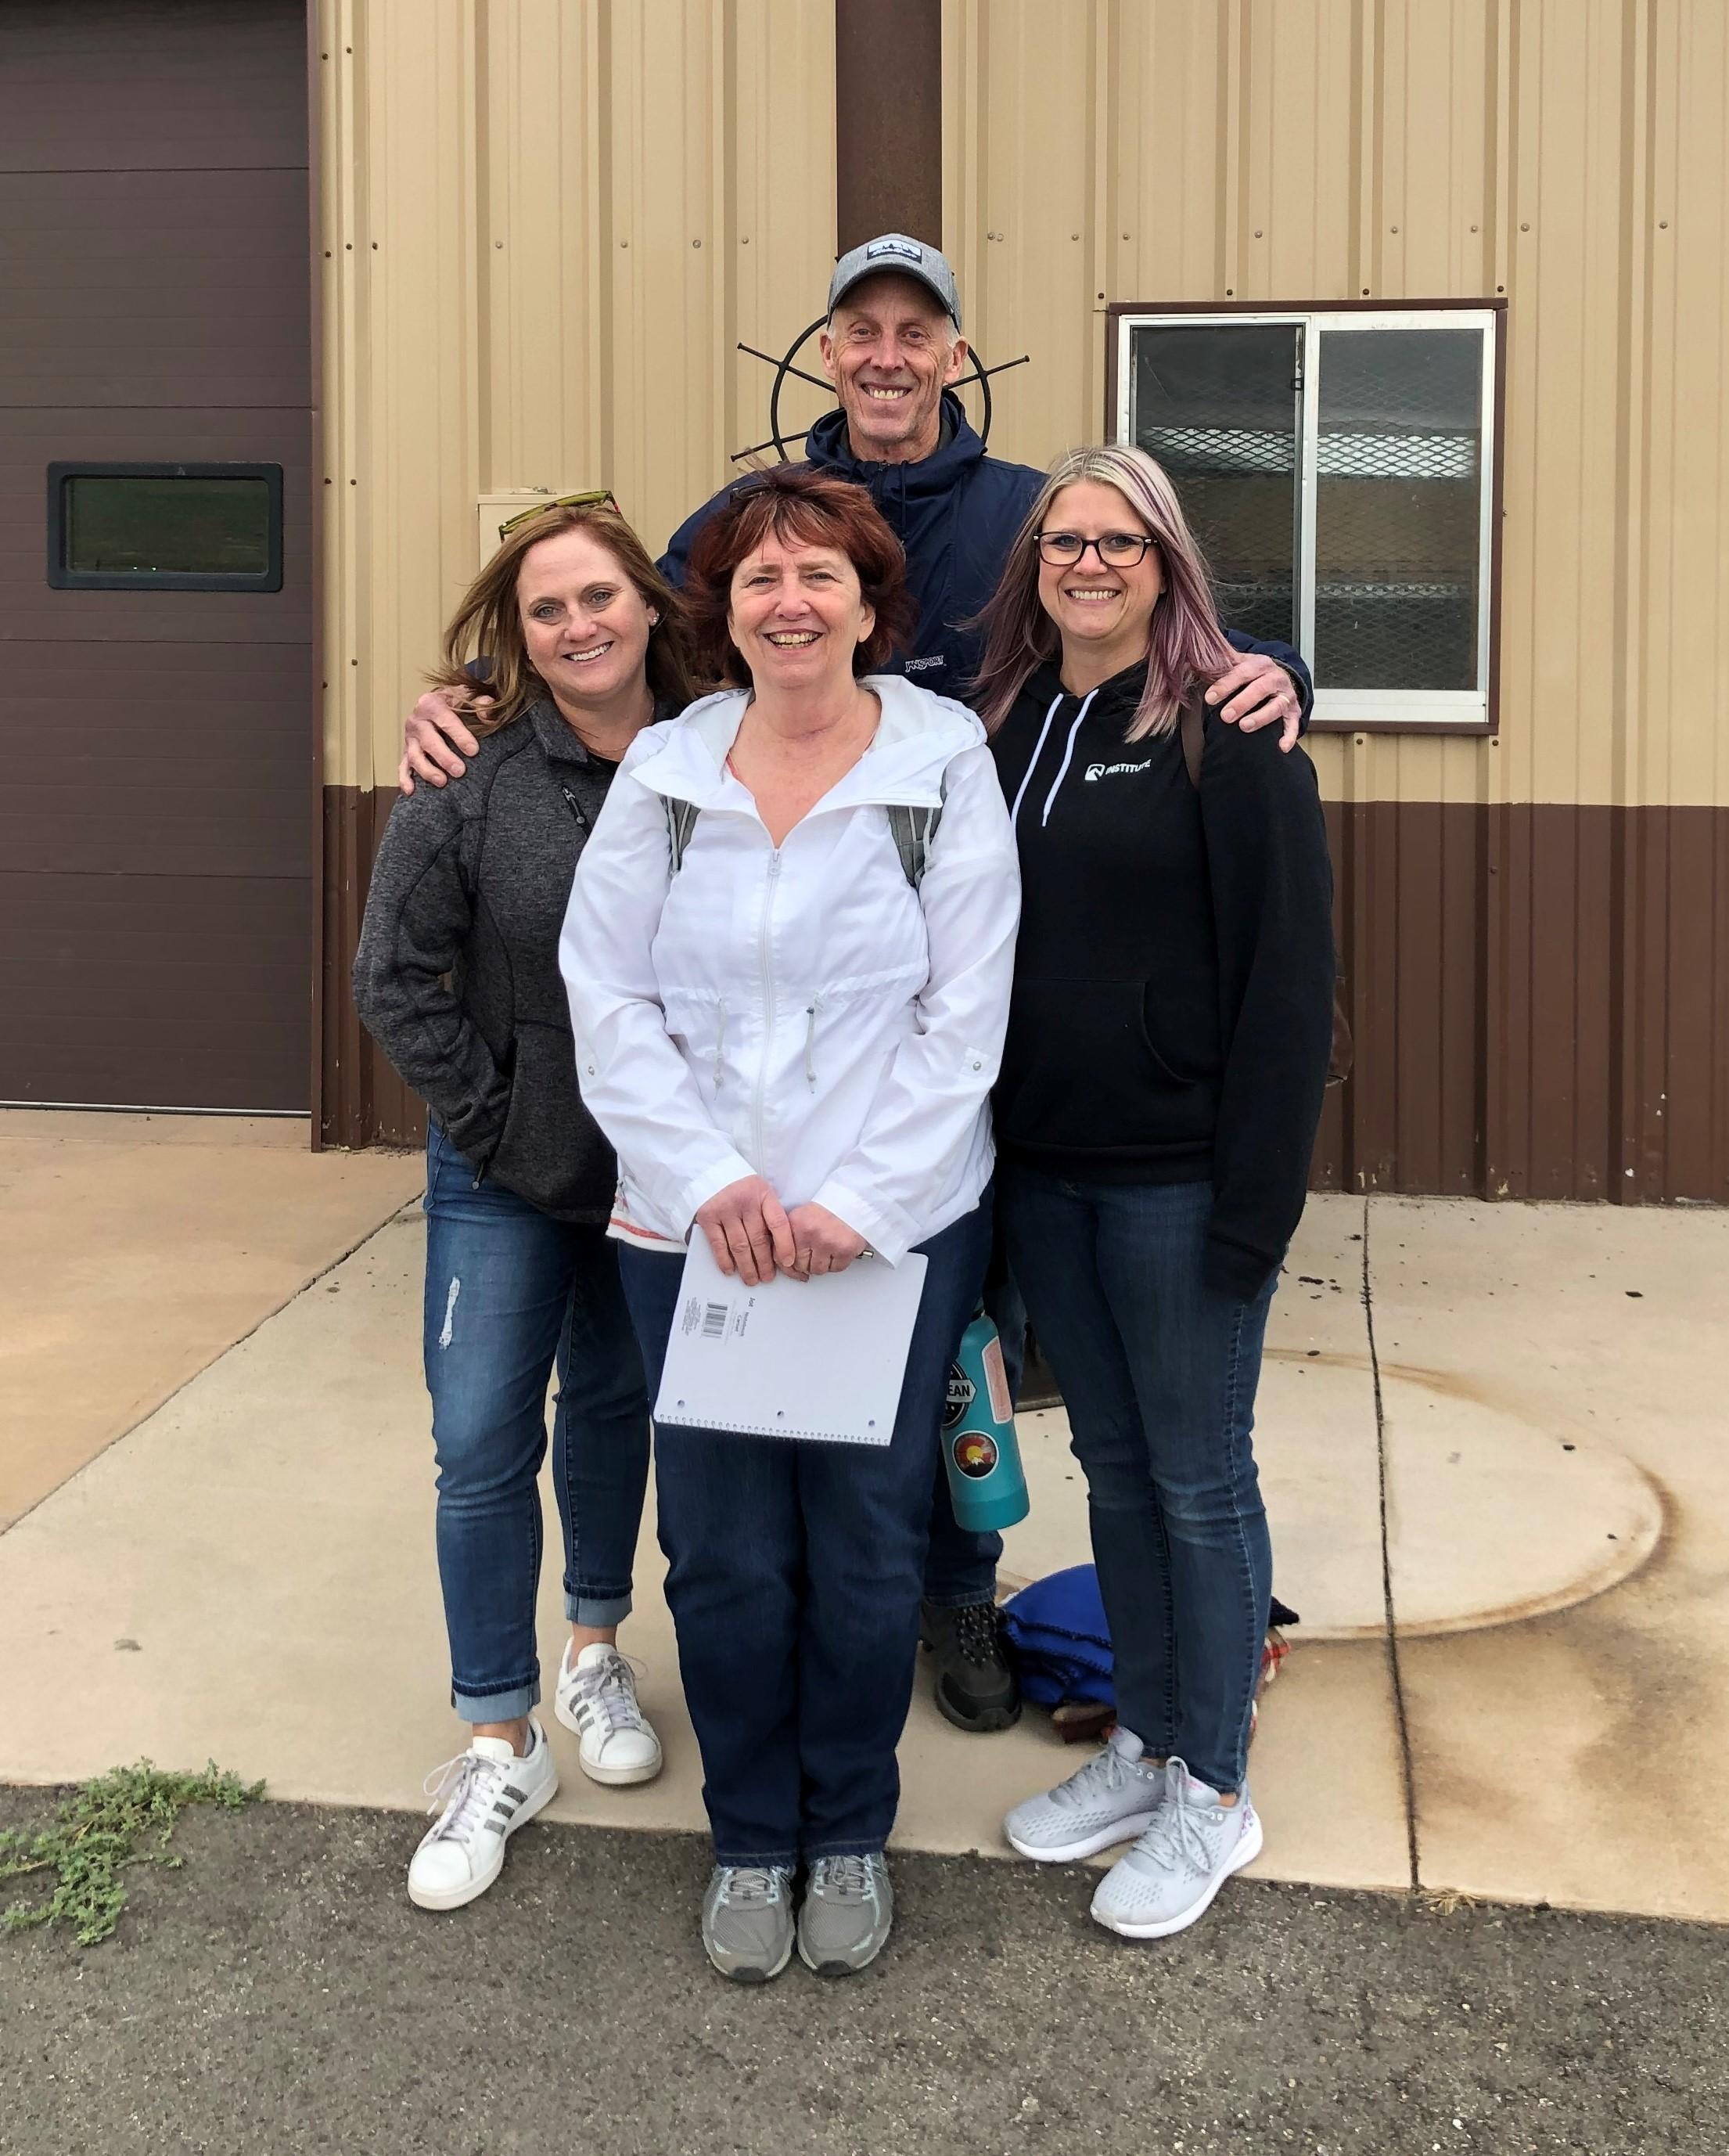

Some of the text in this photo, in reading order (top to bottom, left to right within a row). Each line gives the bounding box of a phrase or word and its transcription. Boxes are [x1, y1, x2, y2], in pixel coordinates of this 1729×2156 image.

[905, 655, 944, 673] JANSPORT
[1105, 758, 1152, 775] INSTITUTE
[948, 1384, 970, 1397] EAN
